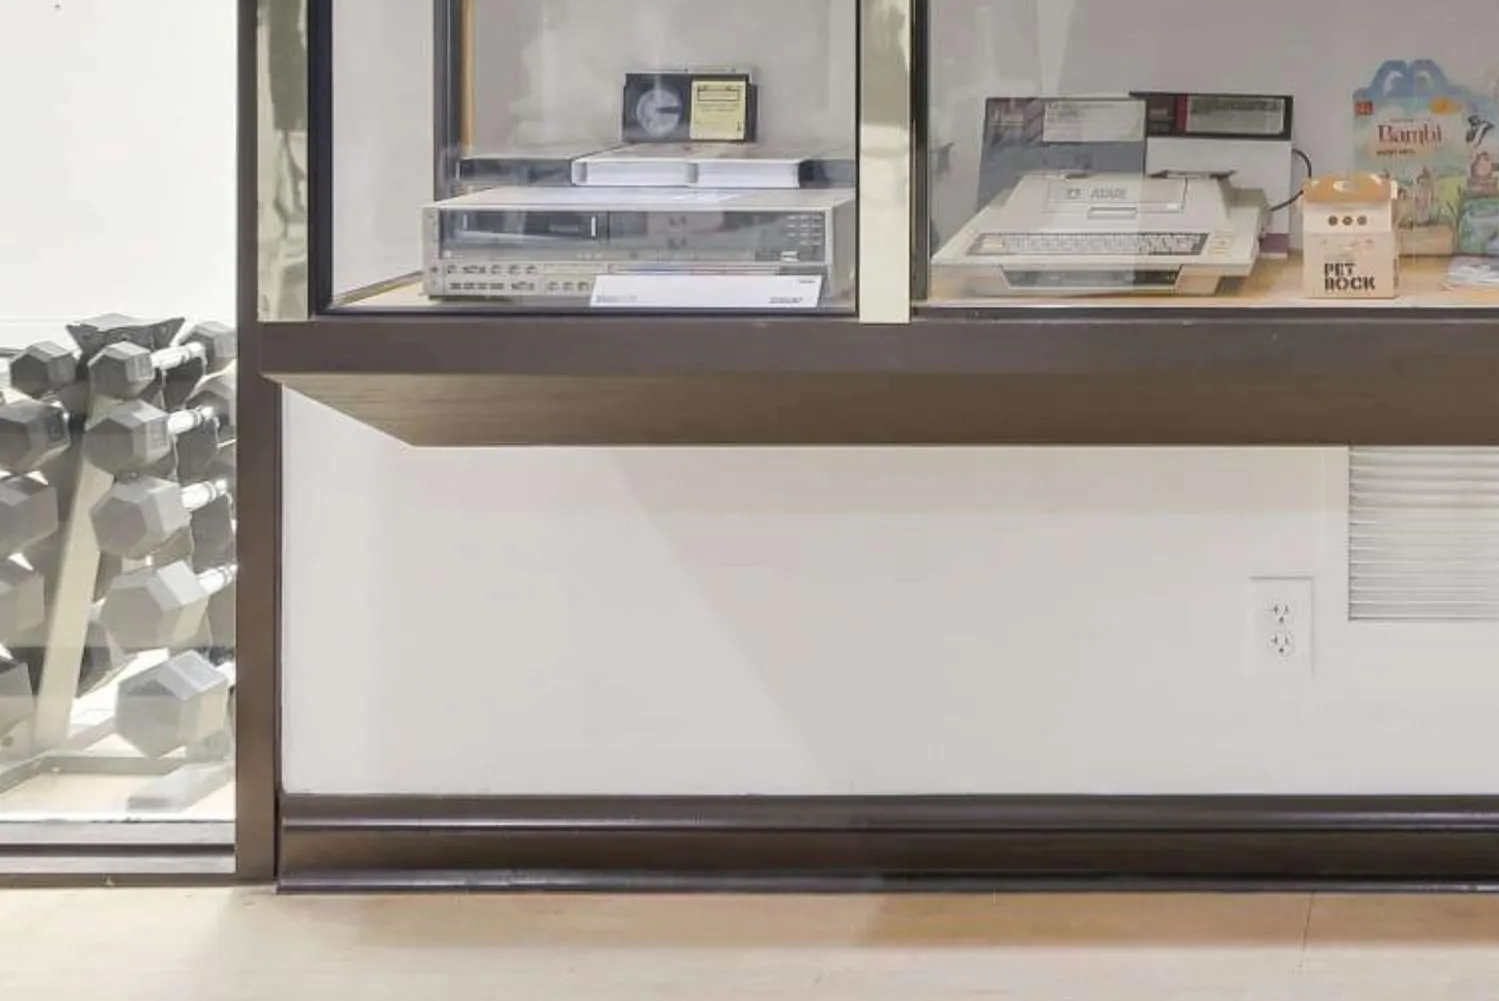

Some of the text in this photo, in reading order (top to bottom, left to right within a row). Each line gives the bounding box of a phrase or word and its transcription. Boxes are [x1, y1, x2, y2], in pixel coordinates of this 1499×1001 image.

[1377, 123, 1442, 145] Bambi
[1324, 262, 1356, 276] PET
[1324, 276, 1376, 291] ROCK
